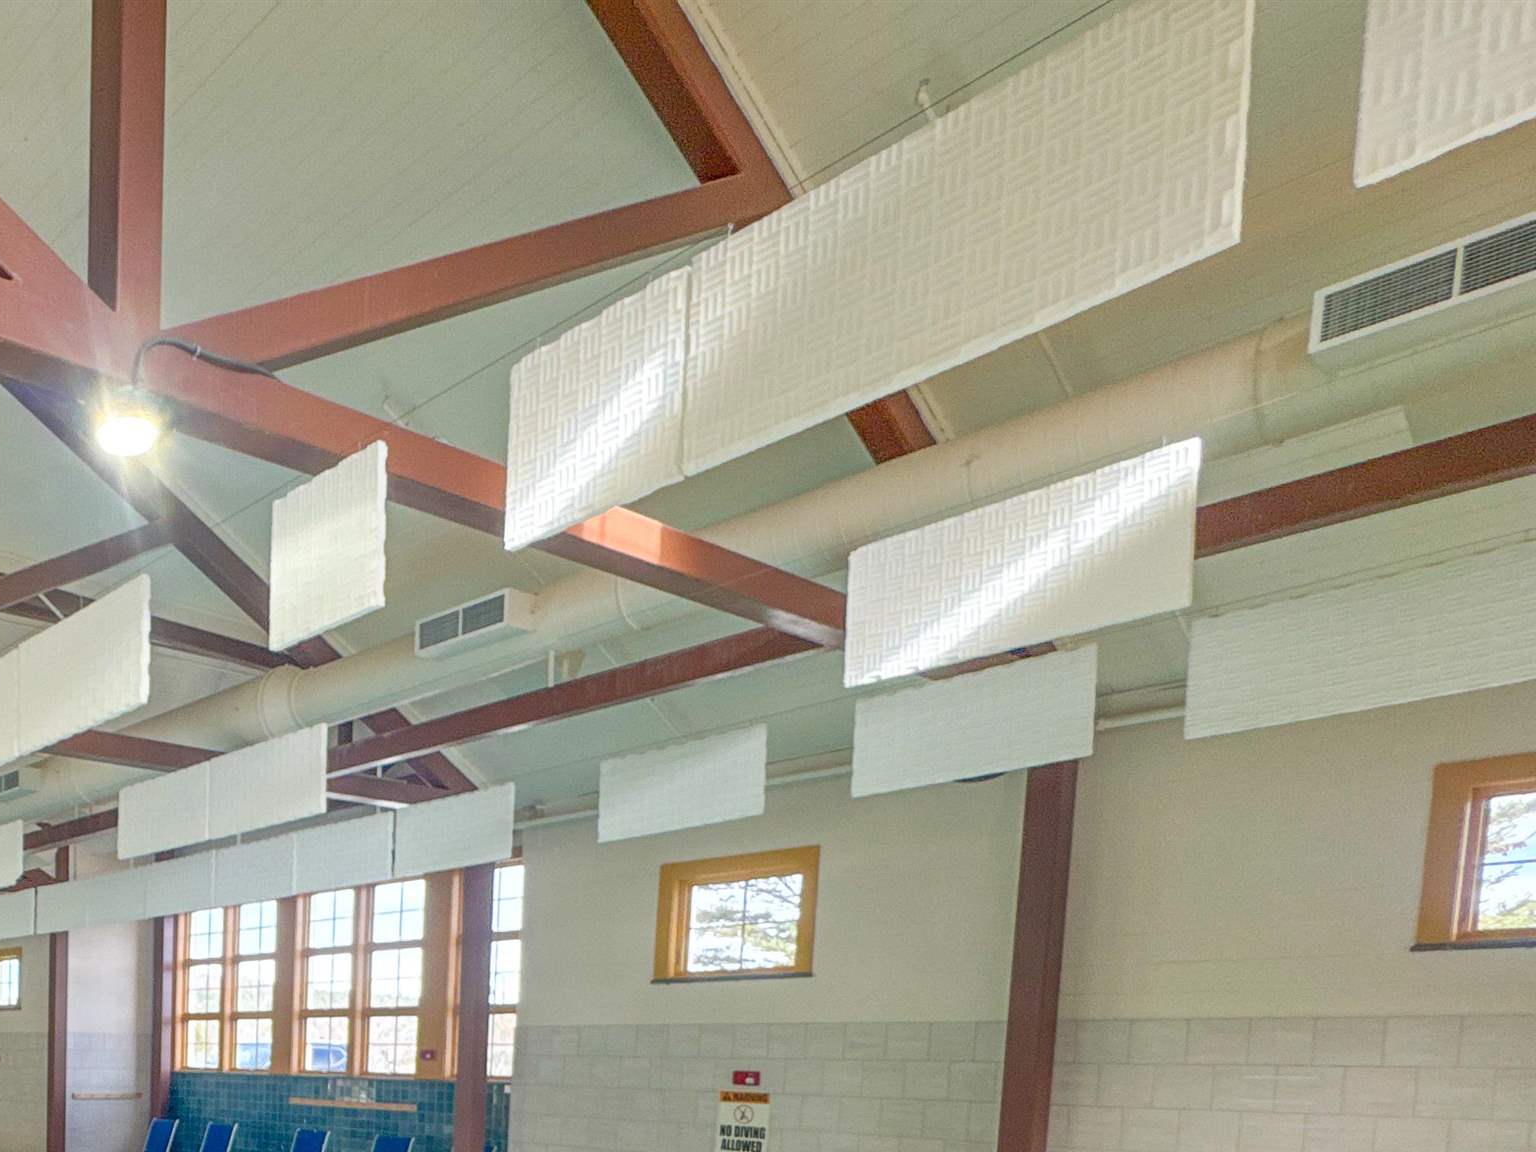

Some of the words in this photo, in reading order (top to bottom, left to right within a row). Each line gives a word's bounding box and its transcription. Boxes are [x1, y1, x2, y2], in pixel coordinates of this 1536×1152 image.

[720, 1125, 732, 1136] NO
[734, 1126, 766, 1139] DIVING
[720, 1139, 763, 1152] ALLOWED
